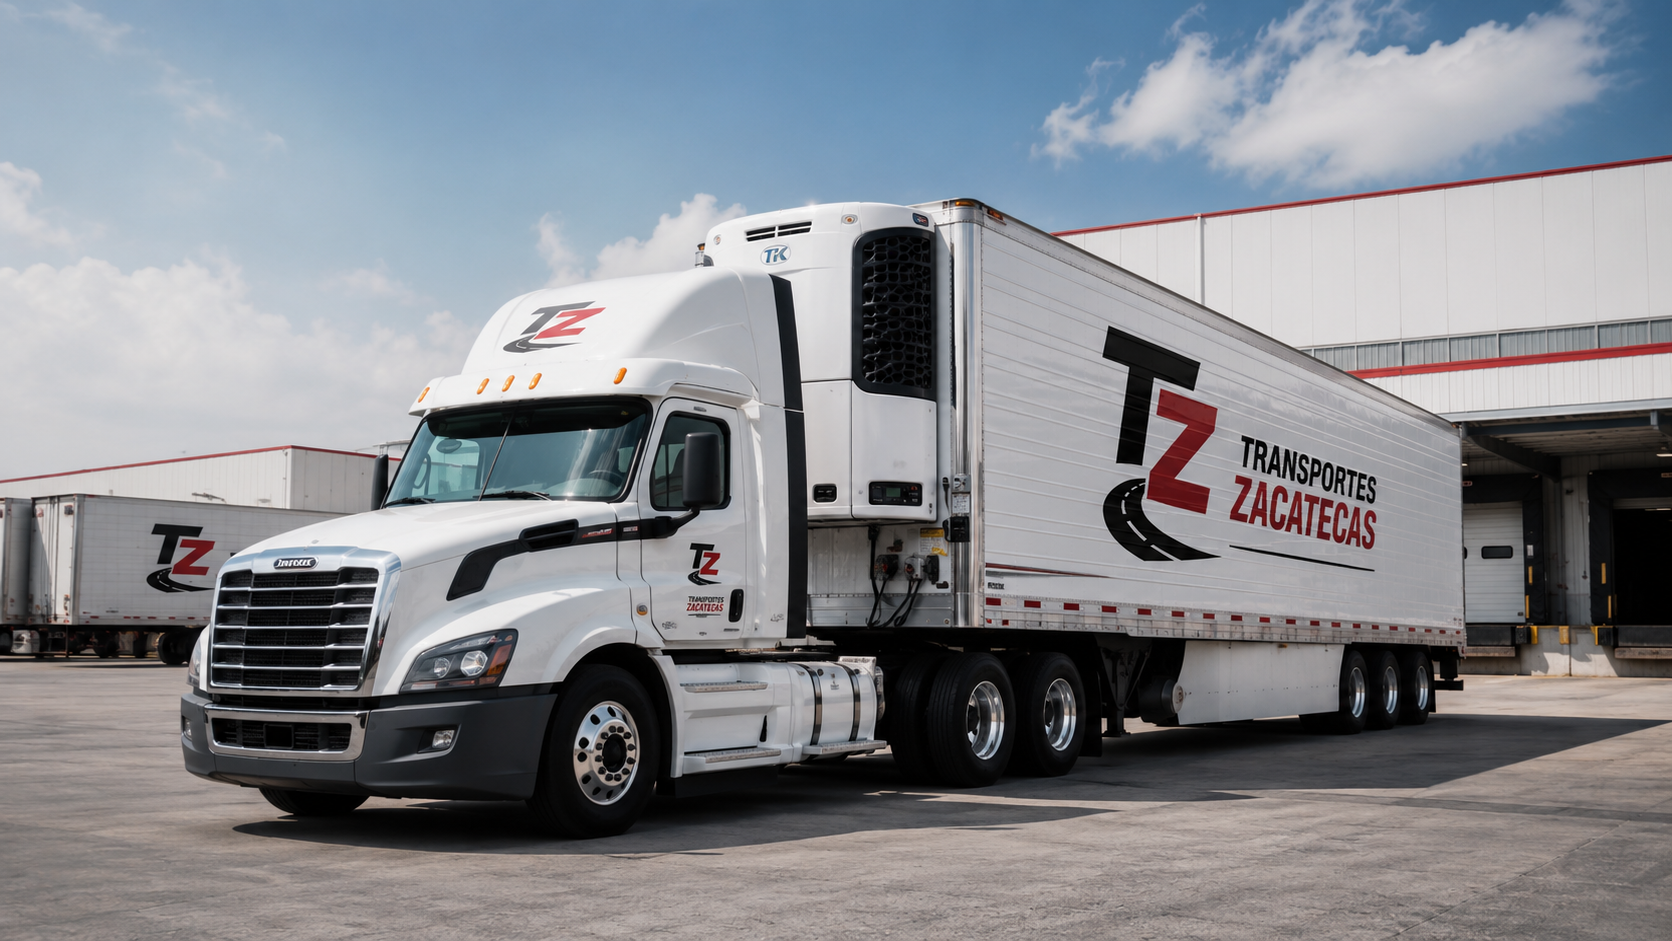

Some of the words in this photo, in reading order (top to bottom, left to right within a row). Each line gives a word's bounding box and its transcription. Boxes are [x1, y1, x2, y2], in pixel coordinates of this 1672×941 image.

[764, 246, 789, 263] TK
[520, 300, 606, 340] TZ
[1102, 325, 1218, 515] TZ
[1241, 435, 1377, 504] TRANSPORTES
[1229, 474, 1377, 550] ZACATECAS
[151, 523, 215, 576] TZ
[689, 542, 721, 575] TZ
